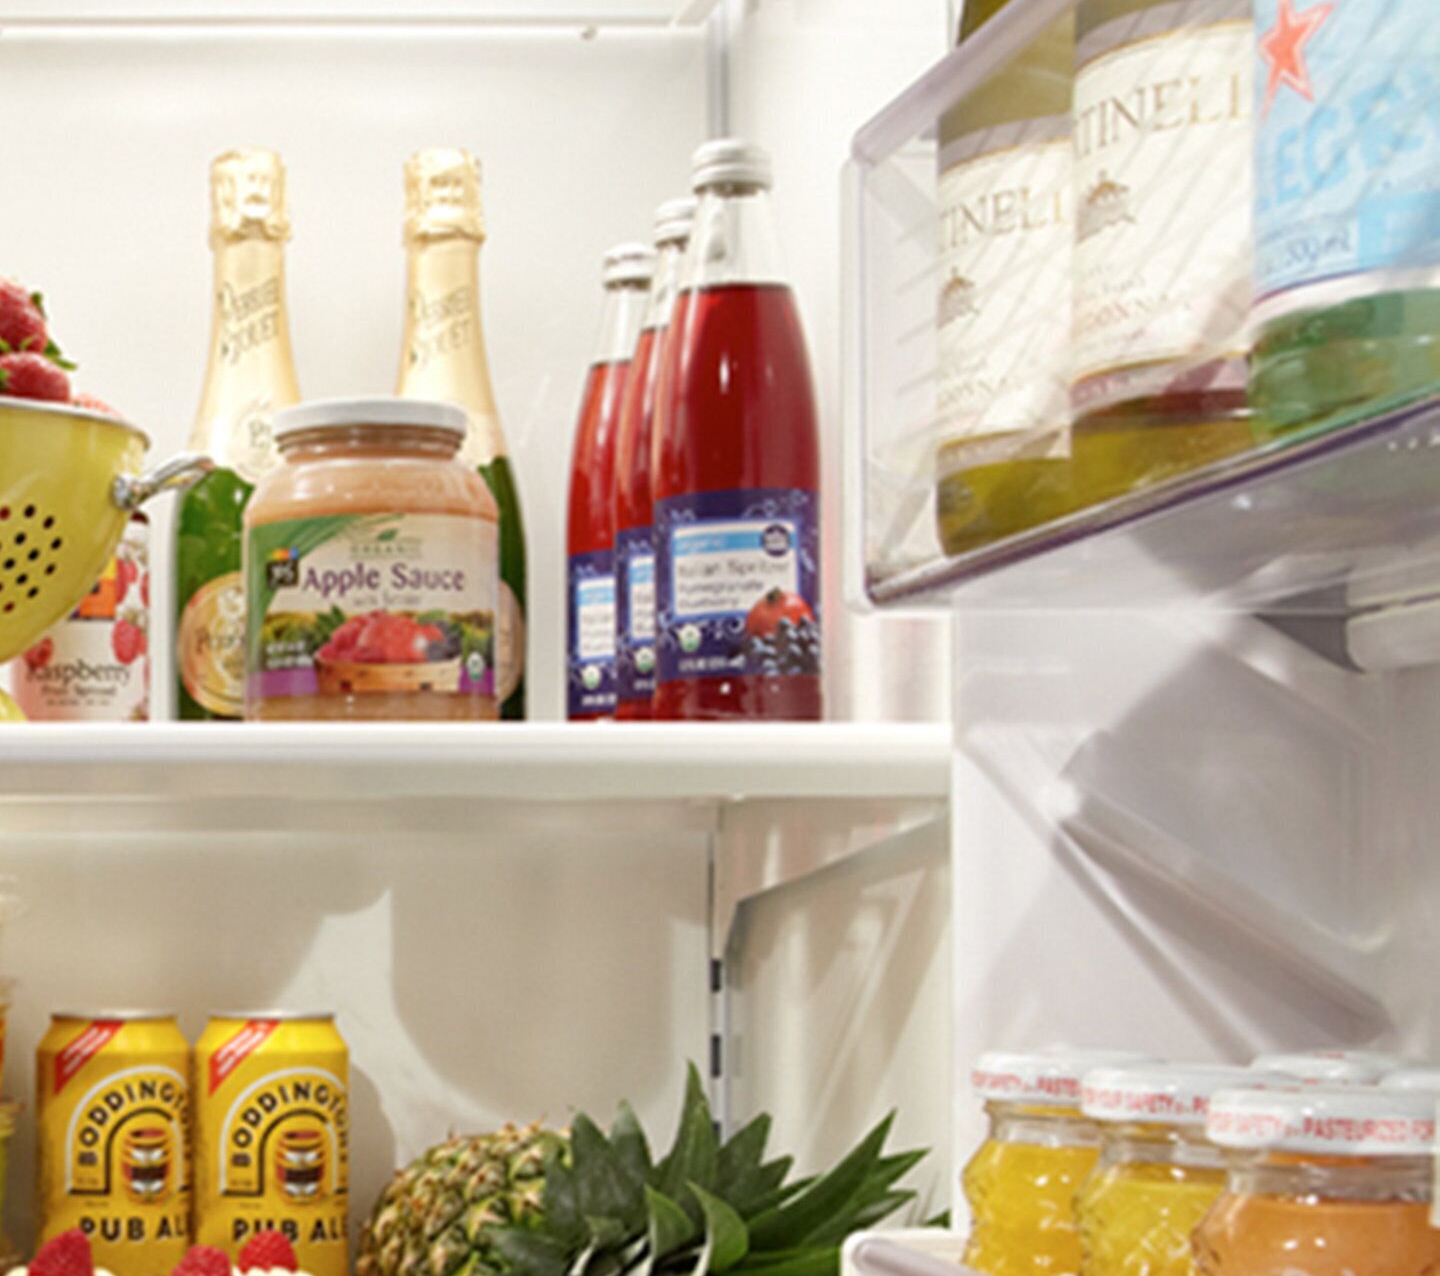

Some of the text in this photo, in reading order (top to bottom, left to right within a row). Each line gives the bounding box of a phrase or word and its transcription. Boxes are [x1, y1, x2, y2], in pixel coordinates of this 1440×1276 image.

[302, 562, 466, 598] Apple Sauce
[26, 658, 130, 687] Raspberry
[78, 1216, 188, 1242] PUB AL
